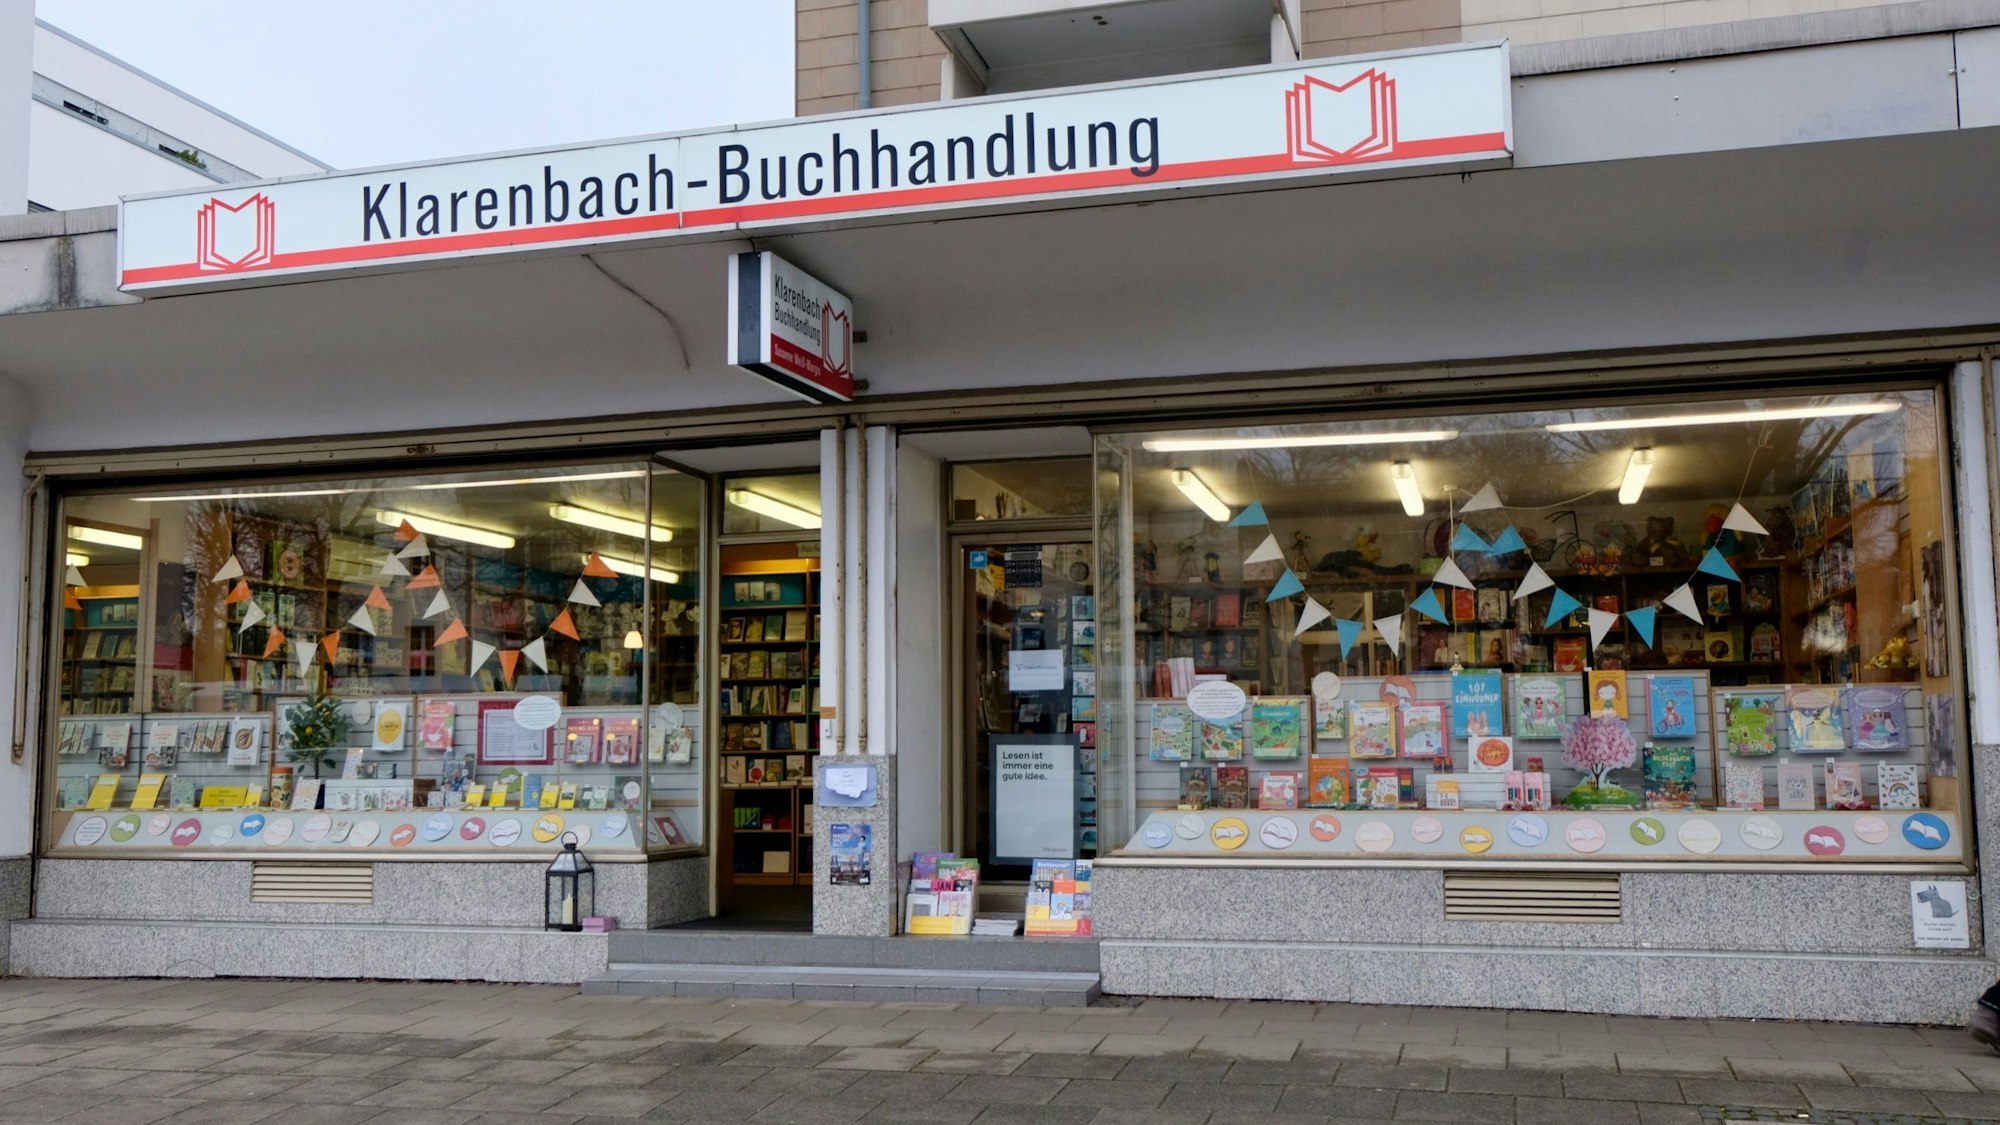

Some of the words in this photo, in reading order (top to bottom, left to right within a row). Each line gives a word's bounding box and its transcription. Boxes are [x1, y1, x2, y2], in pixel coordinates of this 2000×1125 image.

[363, 112, 1161, 243] Klarenbach-Buchhandlung
[775, 274, 820, 321] Klarenbach
[775, 302, 820, 346] Buchhandlung
[1002, 751, 1030, 760] Lesen
[1032, 751, 1043, 760] ist
[1002, 761, 1032, 770] immer
[1034, 761, 1054, 770] eine
[1002, 772, 1024, 782] gute
[1025, 771, 1048, 780] Idee.
